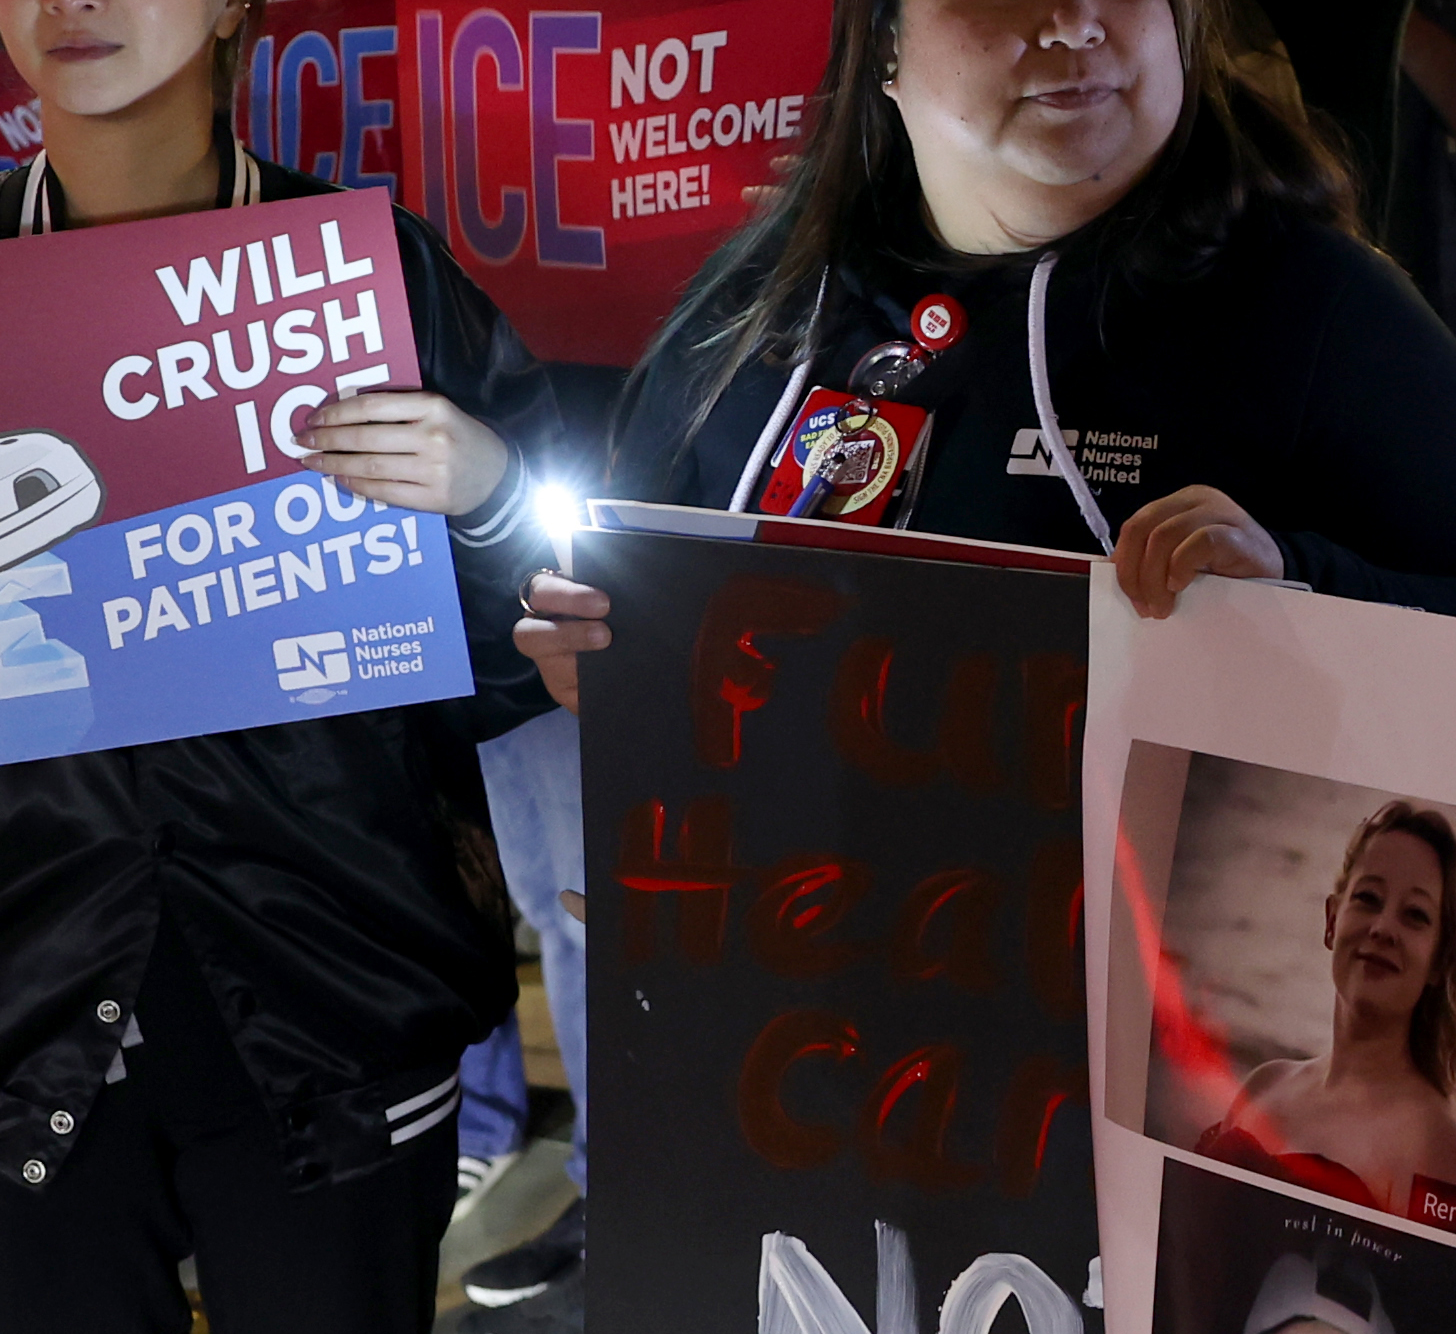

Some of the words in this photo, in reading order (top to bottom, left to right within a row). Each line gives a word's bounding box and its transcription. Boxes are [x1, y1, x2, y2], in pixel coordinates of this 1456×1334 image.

[608, 29, 729, 107] NOT
[249, 25, 399, 197] ICE
[608, 94, 805, 165] WELCOME
[415, 8, 608, 270] ICE
[610, 164, 712, 219] HERE!
[155, 219, 374, 327] WILL
[101, 289, 385, 421] CRUSH
[808, 412, 838, 430] UCS
[1085, 431, 1159, 450] National
[1080, 466, 1141, 485] United
[1081, 448, 1143, 467] Nurses
[123, 500, 256, 581] FOR
[274, 475, 389, 535] OU
[101, 515, 423, 651] PATIENTS!
[351, 616, 435, 644] National
[354, 640, 422, 662] Nurses
[358, 656, 424, 680] United
[1283, 1214, 1318, 1232] rest
[1326, 1218, 1345, 1239] in
